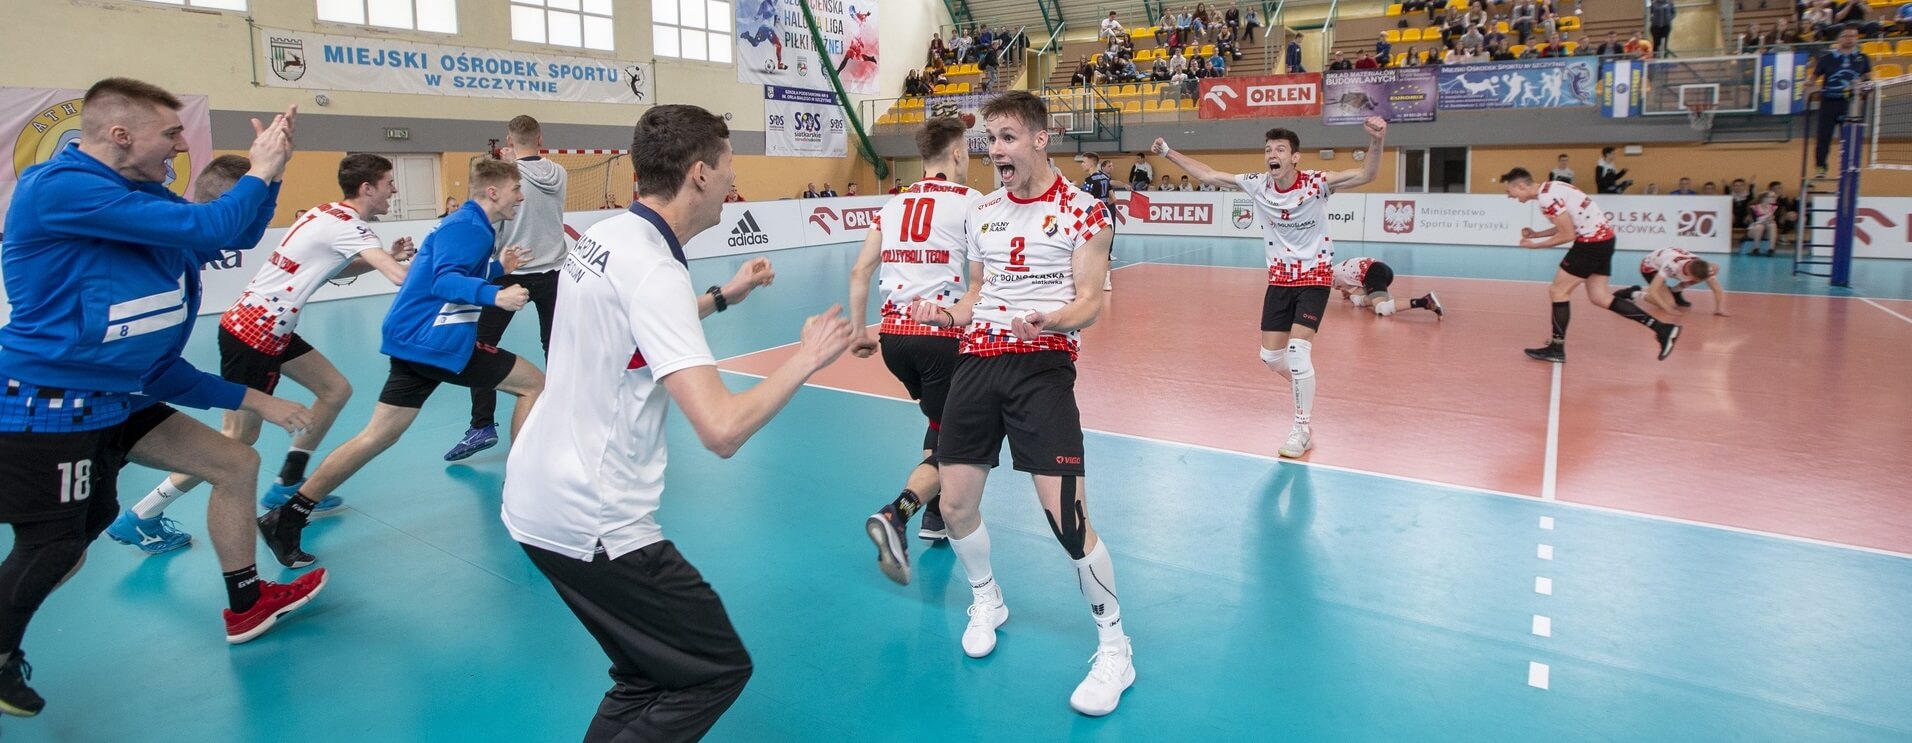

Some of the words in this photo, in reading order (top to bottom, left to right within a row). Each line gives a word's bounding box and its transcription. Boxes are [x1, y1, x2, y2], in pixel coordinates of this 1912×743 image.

[784, 9, 823, 32] HALOA
[825, 19, 844, 35] LIGA
[784, 32, 809, 50] PIŁKI
[811, 39, 844, 55] NŻNEJ
[323, 45, 427, 70] MIEJSKI
[440, 52, 539, 78] OŚRODEK
[548, 63, 618, 83] SPORTU
[425, 73, 442, 86] W
[453, 74, 559, 94] SZCZYTNIE
[1250, 87, 1311, 103] ORLEN
[31, 103, 77, 133] ATH
[845, 211, 878, 227] ORL
[1149, 206, 1208, 222] ORLEN
[1327, 211, 1354, 223] no.pl
[1421, 207, 1486, 216] Ministerstwo
[1604, 211, 1667, 222] OLSKA
[899, 197, 936, 243] 10
[1420, 219, 1452, 229] Sportu
[1463, 220, 1509, 231] Turystyki
[1677, 210, 1718, 237] 90
[727, 232, 769, 247] adidas
[925, 249, 950, 264] TEAM
[1009, 236, 1026, 266] 2
[119, 324, 129, 337] 8
[1064, 456, 1081, 464] VIGO
[57, 458, 93, 503] 18
